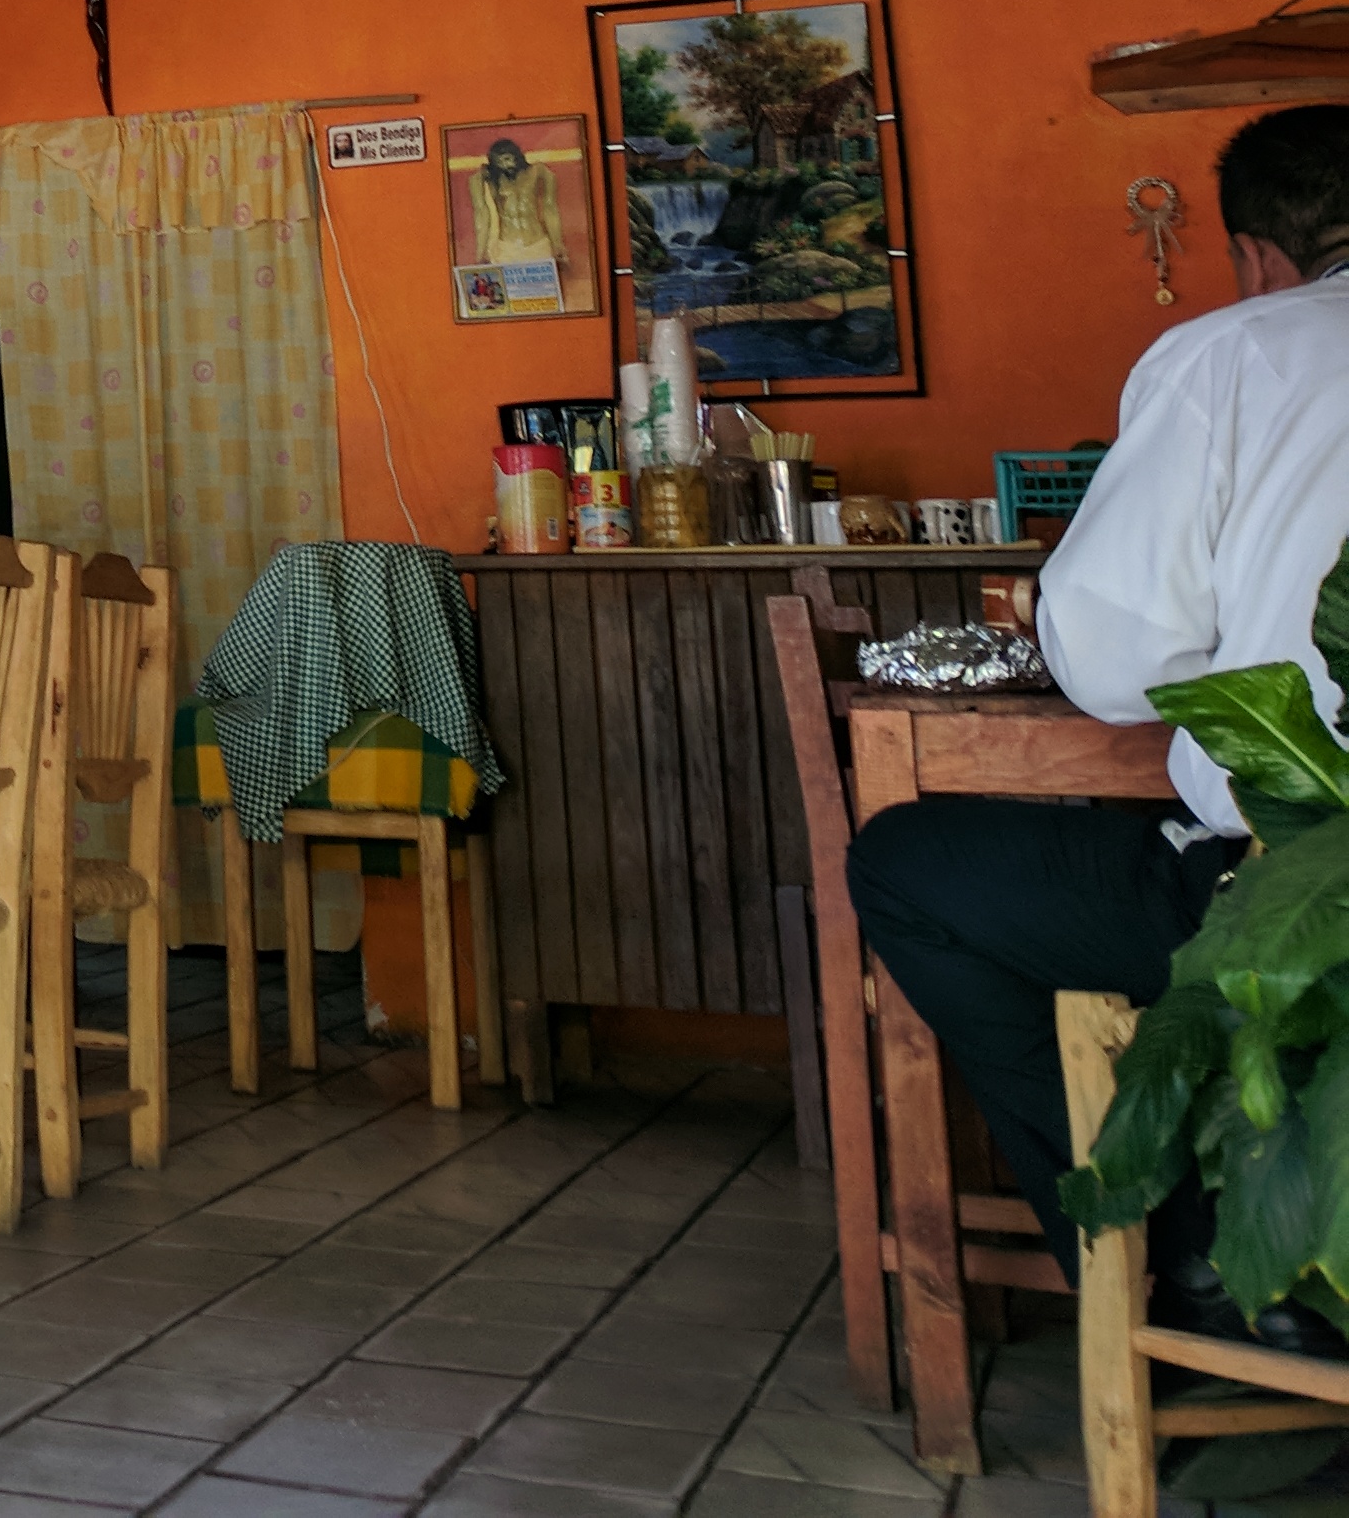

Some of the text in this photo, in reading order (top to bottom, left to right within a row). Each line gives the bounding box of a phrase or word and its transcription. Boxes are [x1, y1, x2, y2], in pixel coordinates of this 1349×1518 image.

[356, 125, 420, 143] Dios Bendiga
[360, 143, 420, 159] Mis Clientes
[600, 483, 614, 503] 3
